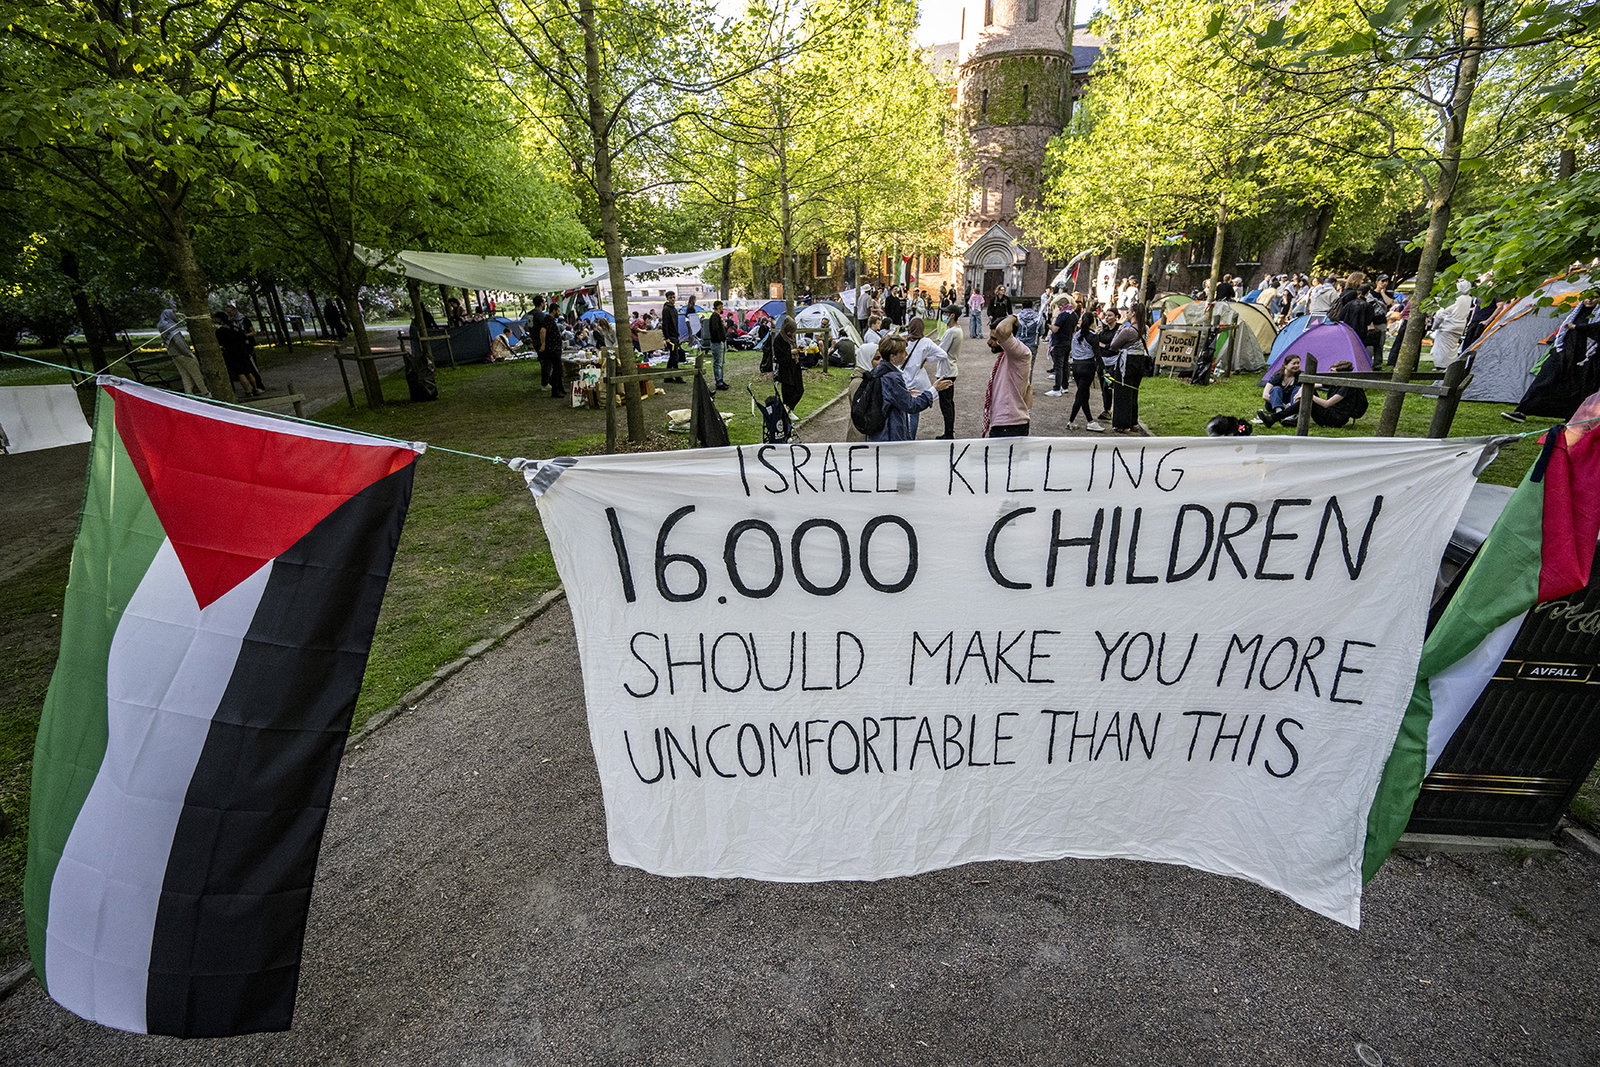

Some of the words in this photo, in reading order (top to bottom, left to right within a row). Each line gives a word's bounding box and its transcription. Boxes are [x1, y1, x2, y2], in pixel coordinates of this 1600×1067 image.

[1163, 335, 1197, 347] STUDENT
[736, 444, 900, 497] ISRAEL
[947, 442, 1188, 495] KILLING
[604, 504, 919, 605] 16.000
[984, 494, 1385, 590] CHILDREN
[623, 630, 866, 699] SHOULD
[907, 630, 1062, 687] MAKE
[1094, 630, 1199, 686] YOU
[1215, 633, 1377, 705] MORE
[1529, 666, 1579, 677] AVFALL
[623, 711, 1020, 785] UNCOMFORTABLE
[1040, 709, 1162, 765] THAN
[1182, 710, 1305, 779] THIS
